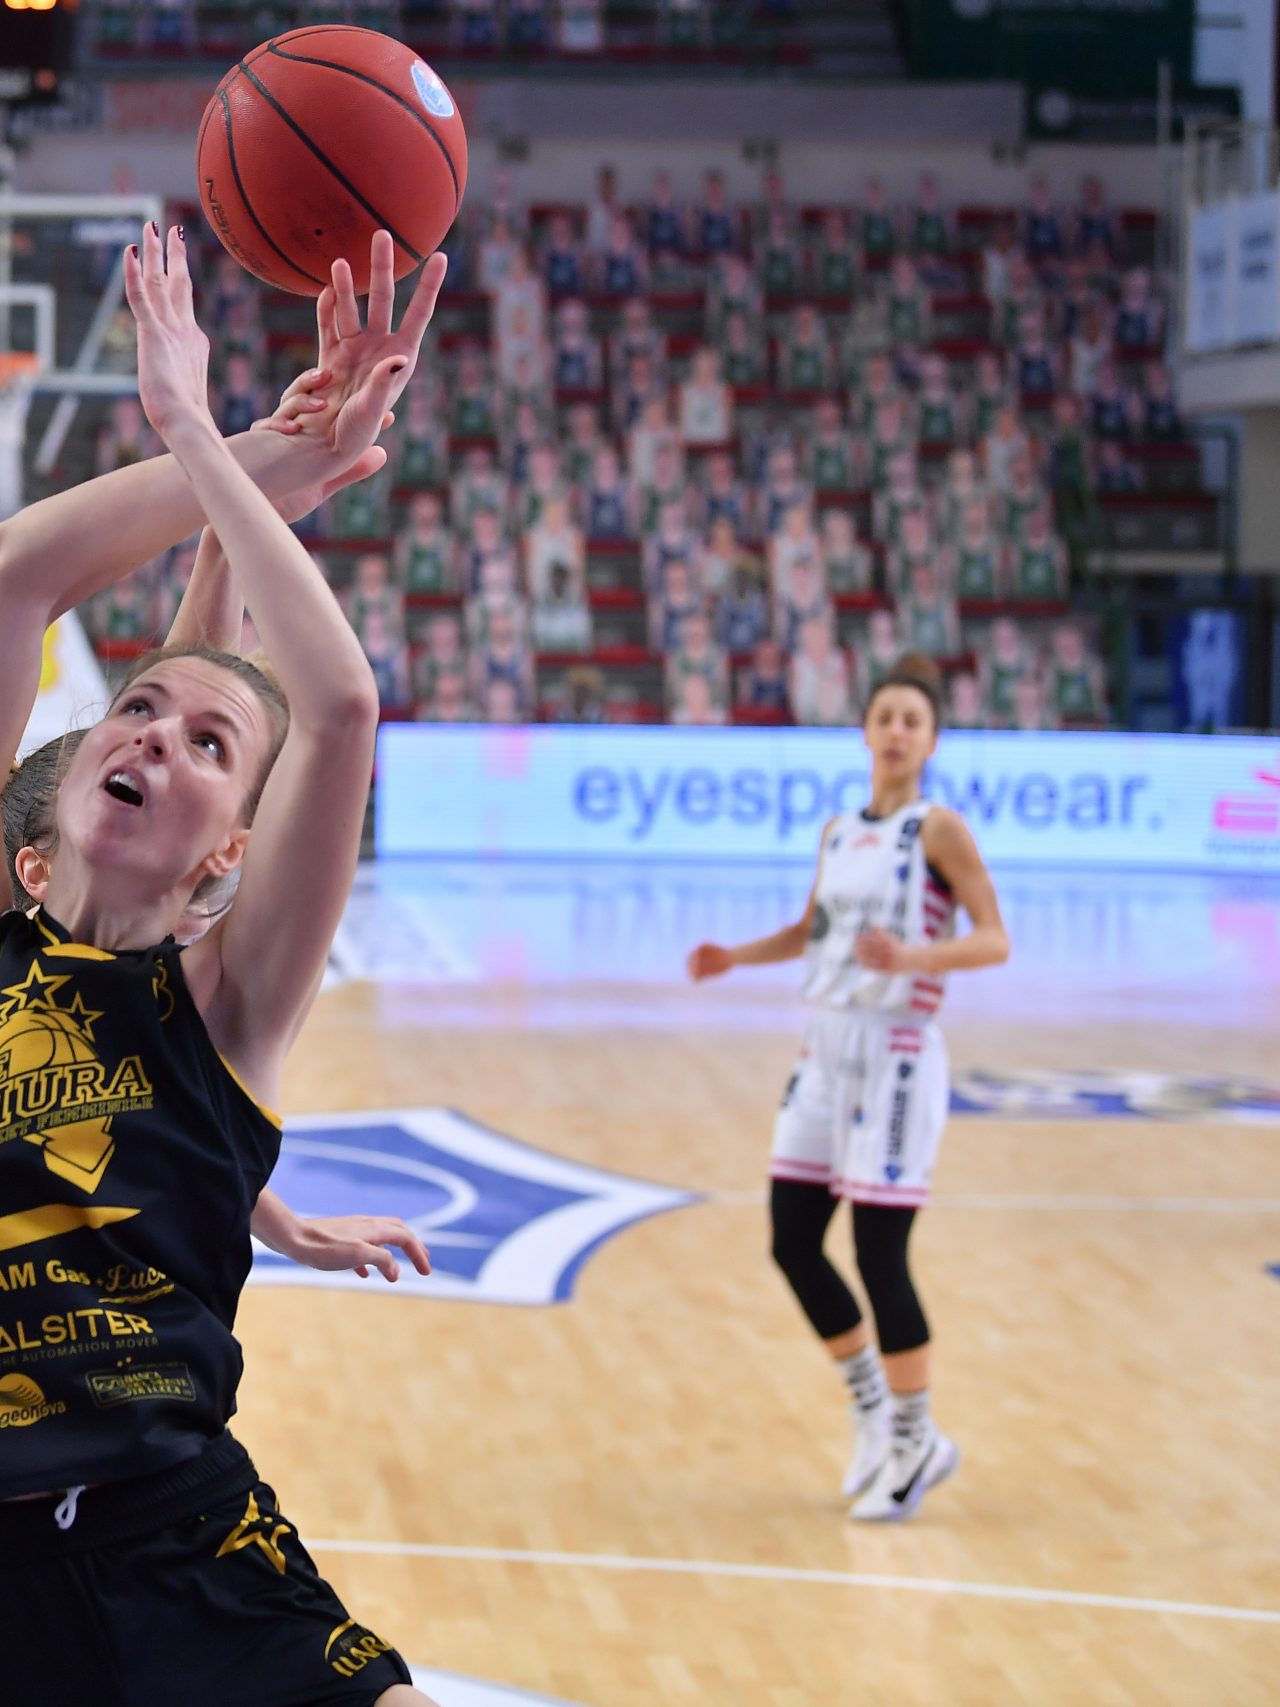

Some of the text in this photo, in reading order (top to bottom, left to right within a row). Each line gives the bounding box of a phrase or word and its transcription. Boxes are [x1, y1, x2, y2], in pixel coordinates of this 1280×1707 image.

[571, 764, 1164, 840] eyespowear.
[45, 1259, 91, 1286] Gas
[104, 1263, 167, 1293] Luc
[21, 1340, 111, 1364] AUTOMATION
[114, 1336, 159, 1348] MOVER
